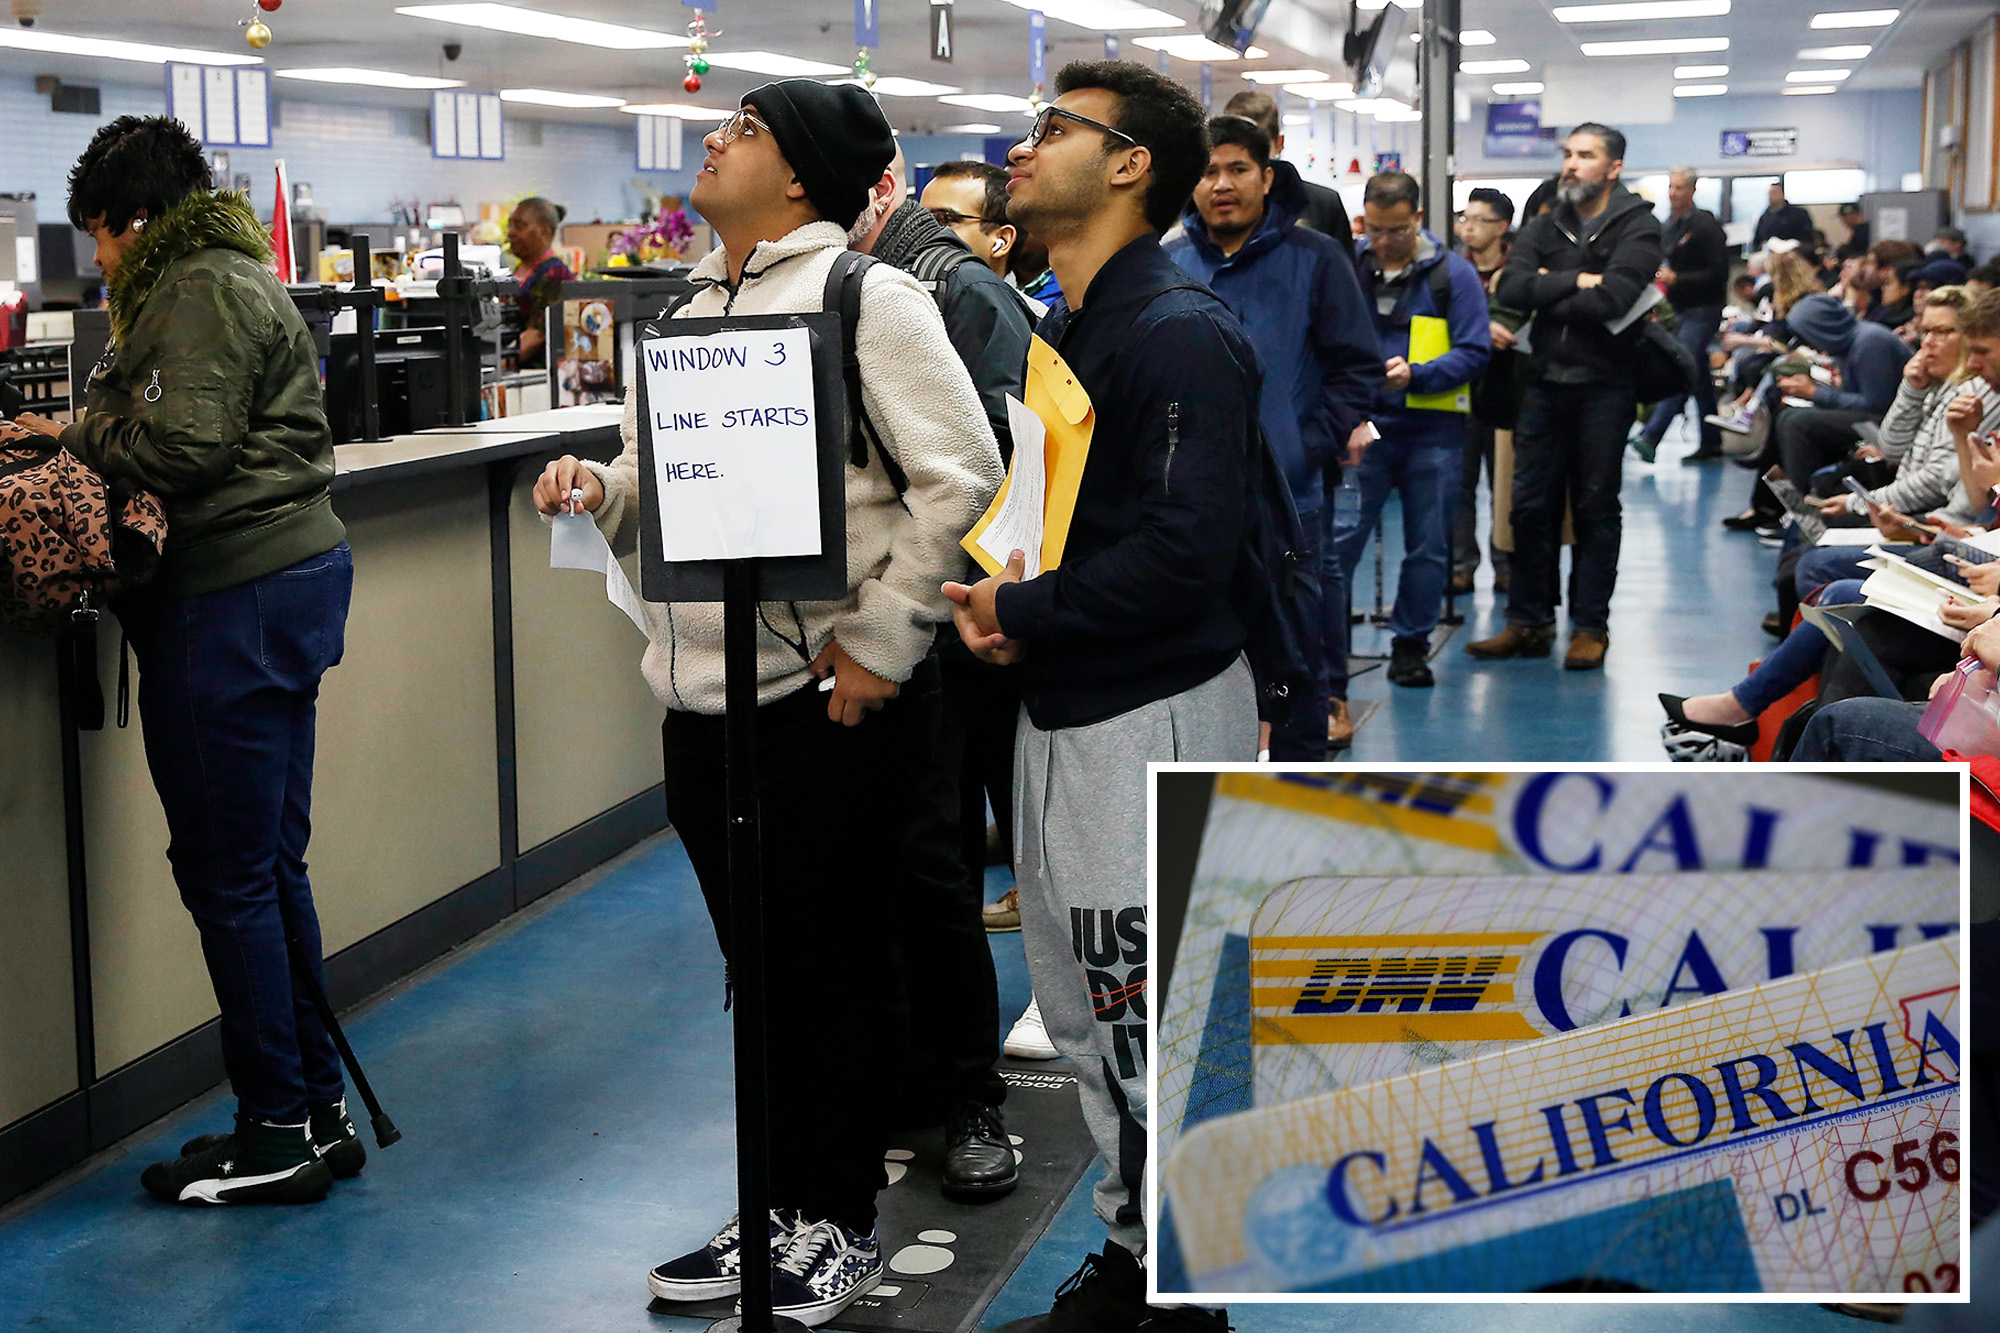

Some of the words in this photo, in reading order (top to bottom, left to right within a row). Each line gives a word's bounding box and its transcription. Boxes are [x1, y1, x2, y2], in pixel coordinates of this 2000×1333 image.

[937, 9, 950, 58] A
[648, 346, 747, 372] WINDOW
[764, 342, 786, 366] 3
[657, 412, 709, 431] LINE
[721, 407, 809, 428] STARTS
[665, 462, 724, 483] HERE.
[1070, 907, 1147, 968] JUS
[1292, 956, 1504, 1014] DMV
[1004, 1080, 1063, 1089] DOCU
[1326, 1009, 1960, 1229] CALIFORNIA
[1773, 1188, 1827, 1224] DL
[1844, 1131, 1960, 1203] C56
